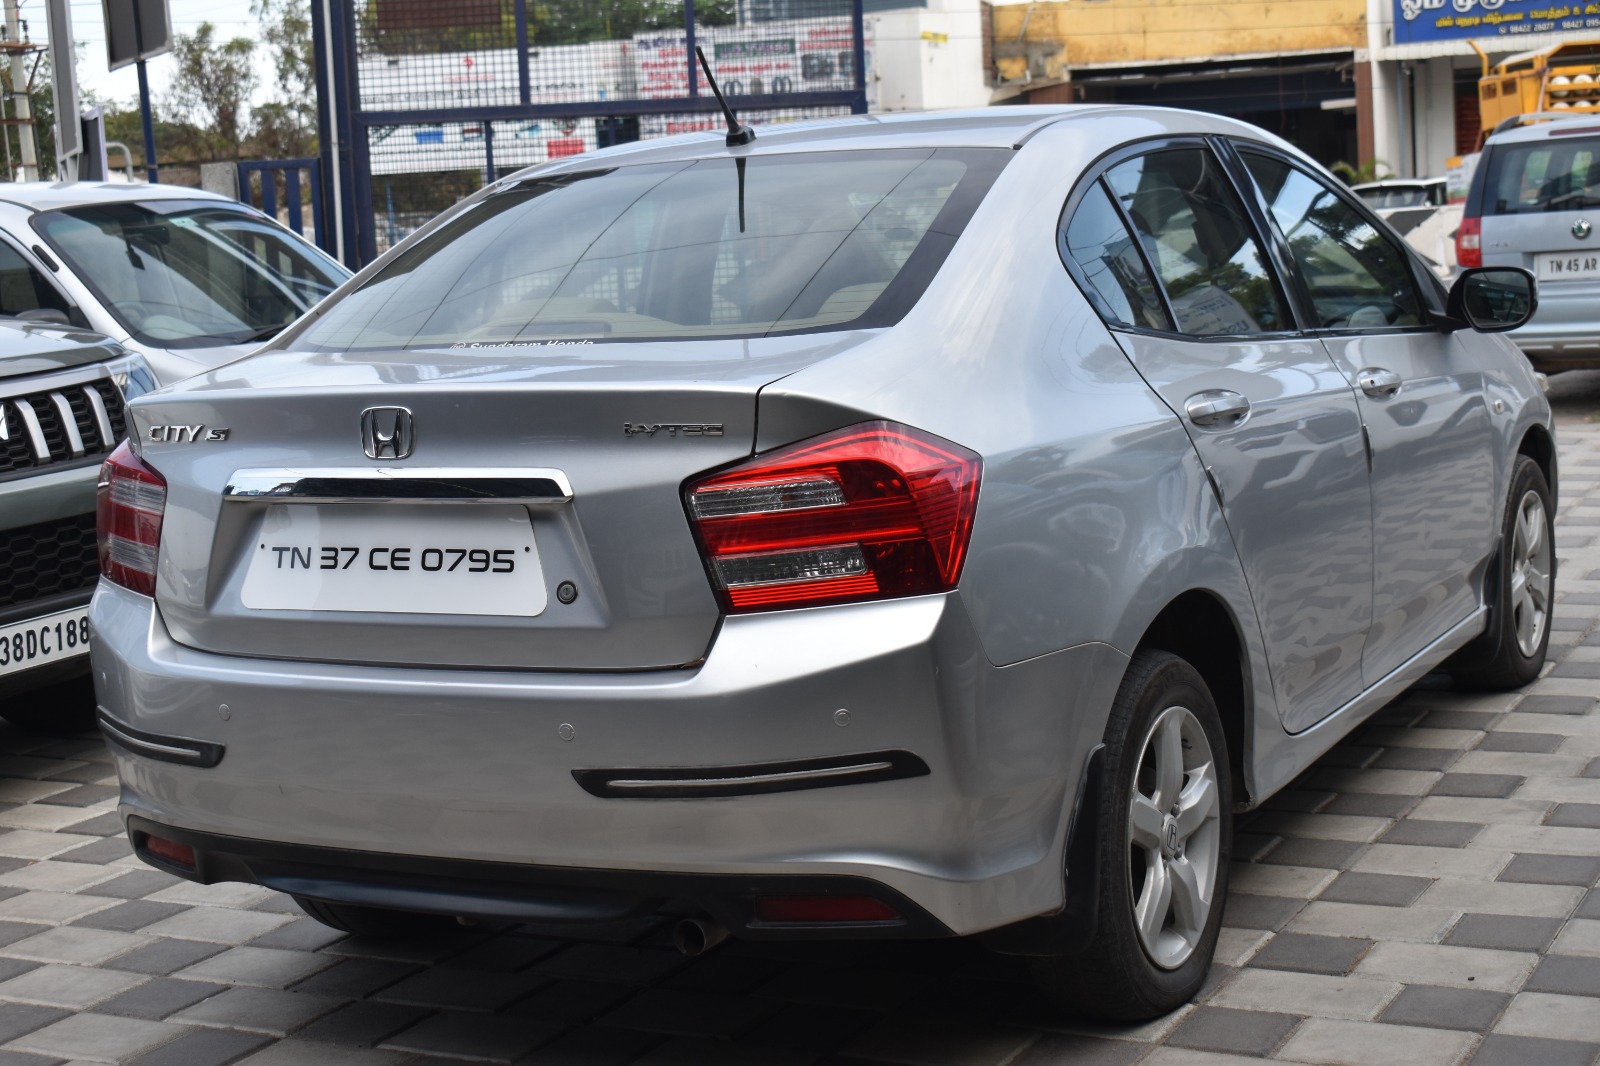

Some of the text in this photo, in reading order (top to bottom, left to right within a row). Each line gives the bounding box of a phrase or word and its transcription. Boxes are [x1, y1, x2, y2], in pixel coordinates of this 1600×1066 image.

[1550, 258, 1597, 273] TN 45 AR
[149, 424, 205, 442] CITY
[272, 546, 515, 573] TN 37 CE 0795
